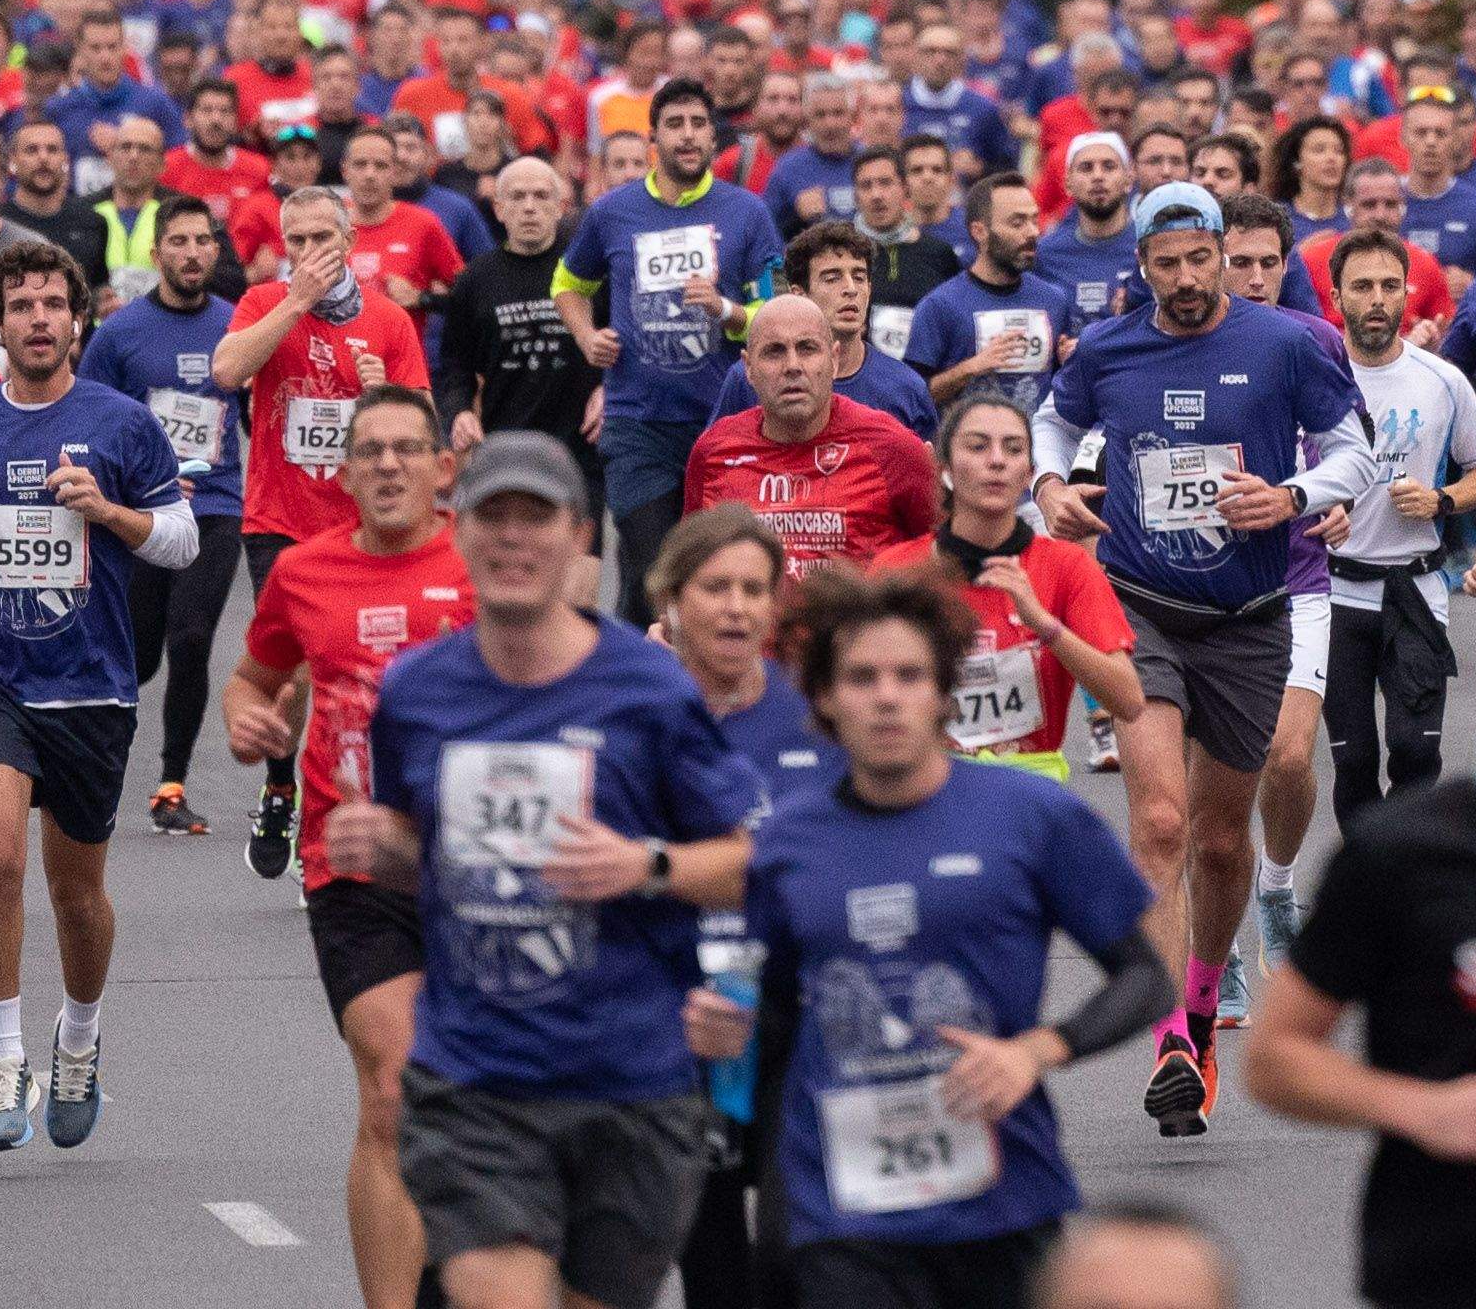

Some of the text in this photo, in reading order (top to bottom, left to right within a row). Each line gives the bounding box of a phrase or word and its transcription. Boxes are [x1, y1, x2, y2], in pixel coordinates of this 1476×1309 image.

[648, 250, 705, 277] 6720
[1219, 374, 1249, 386] HOKA
[1163, 479, 1219, 510] 759
[957, 686, 1024, 724] 714
[477, 794, 551, 831] 347
